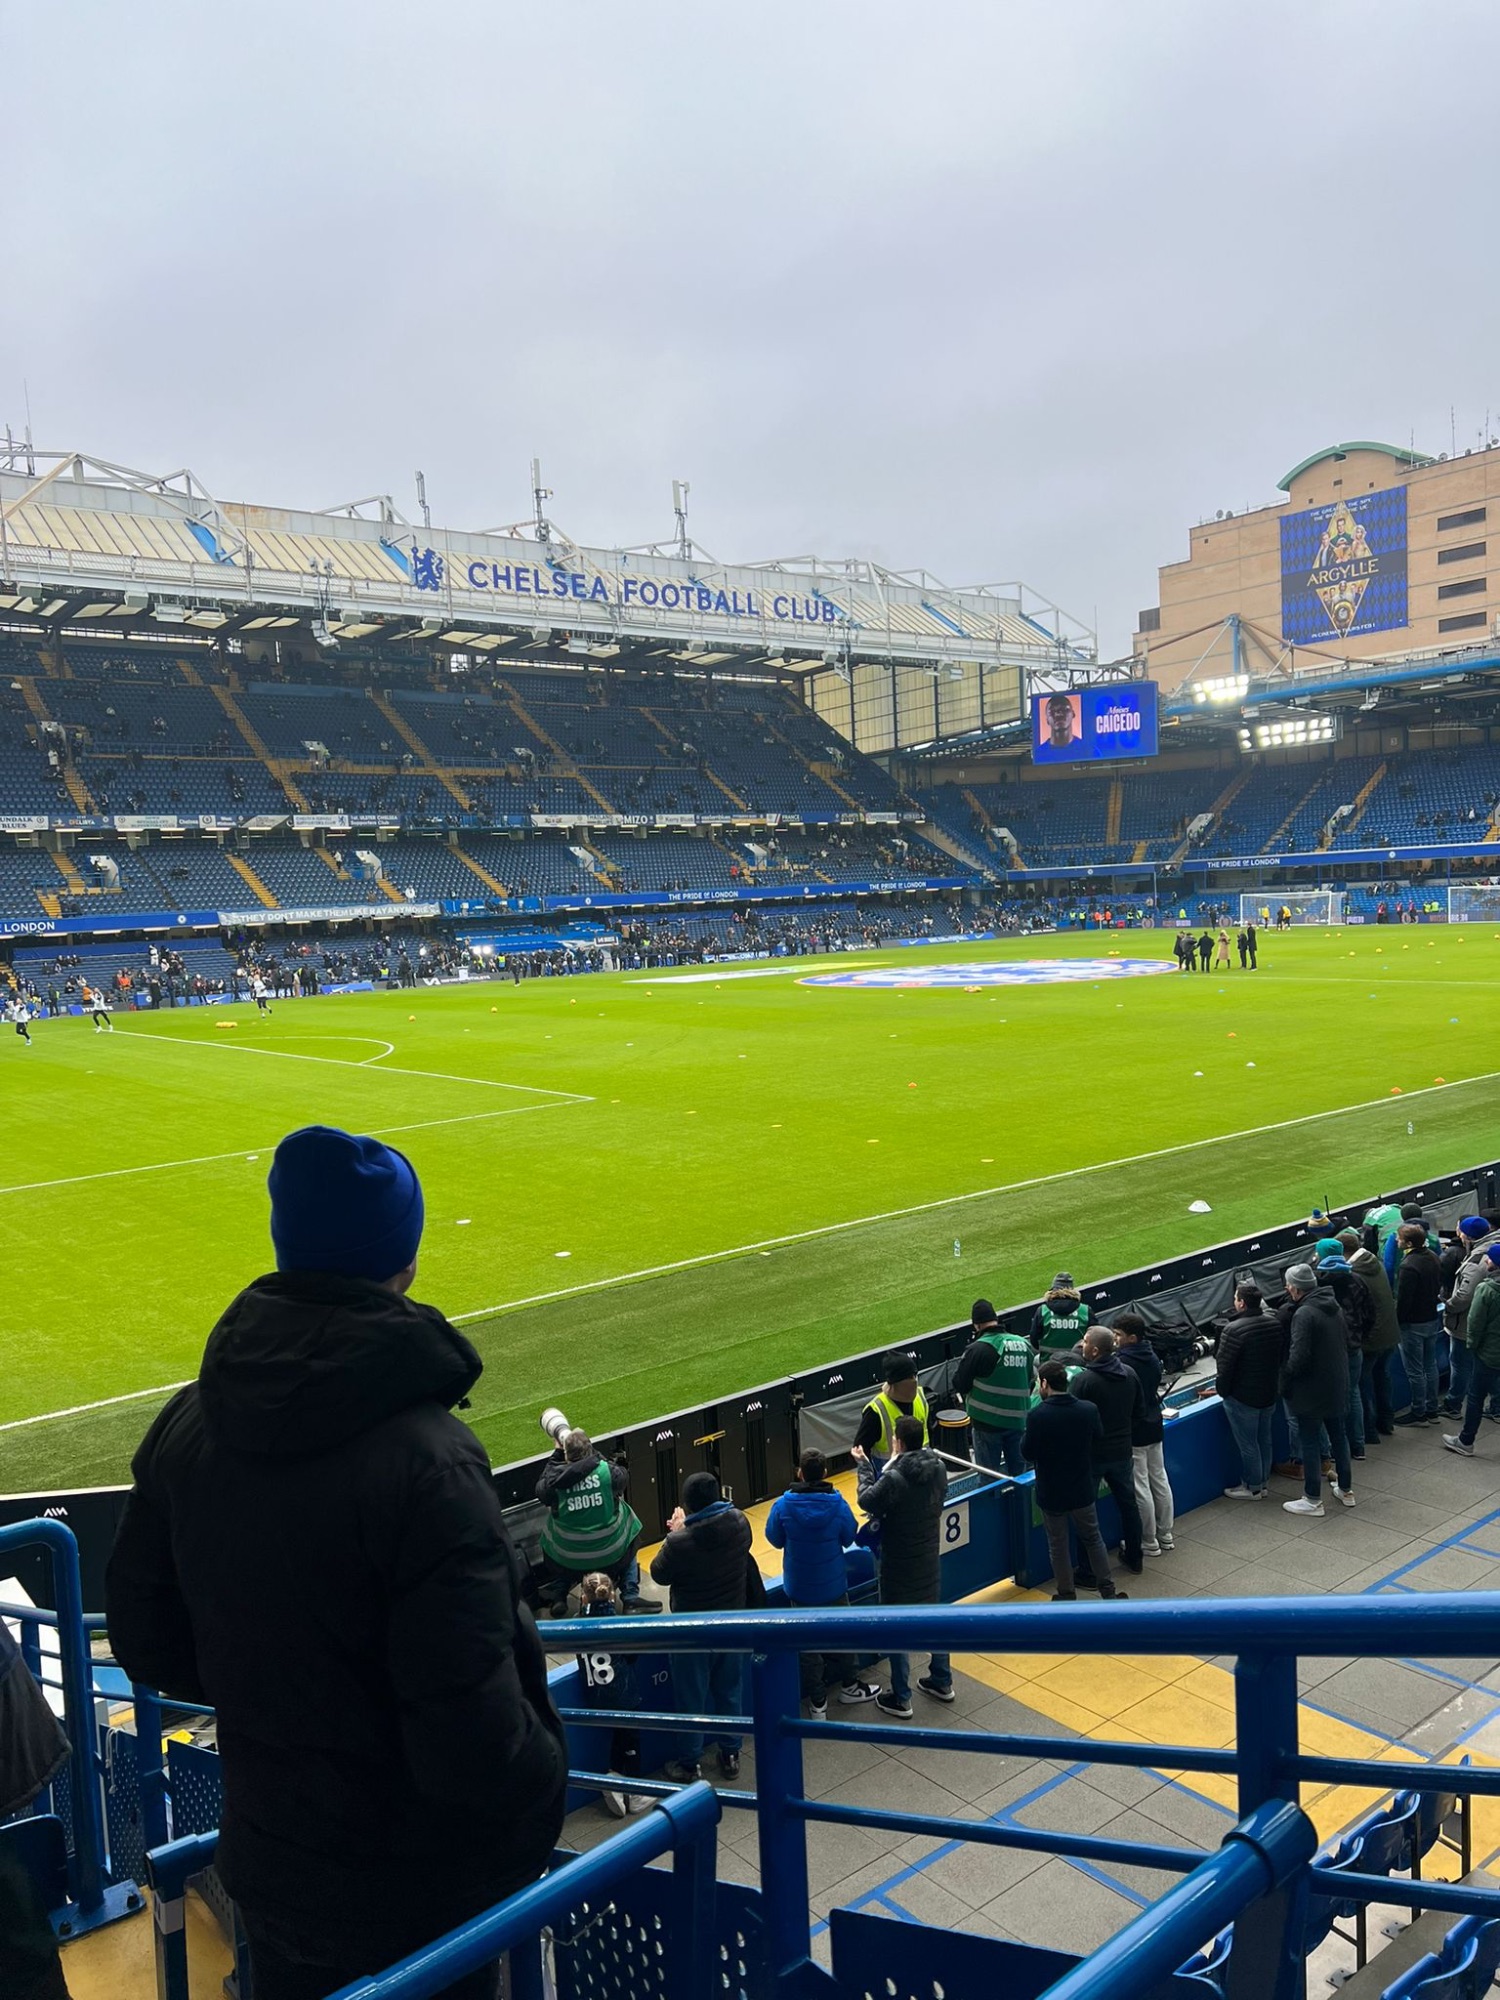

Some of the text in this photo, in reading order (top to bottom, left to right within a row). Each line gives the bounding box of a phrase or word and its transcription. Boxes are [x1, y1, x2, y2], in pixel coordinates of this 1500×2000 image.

[1307, 558, 1379, 587] ARGYLLE
[468, 561, 836, 623] CHELSEA FOOTBALL CLUB
[1096, 712, 1141, 733] CAICEDO
[624, 815, 648, 824] MIZO
[1251, 858, 1280, 866] LONDON
[683, 892, 702, 900] PRIDE
[711, 891, 739, 899] LONDON
[240, 914, 266, 922] THEY
[296, 910, 322, 918] MAKE
[325, 909, 348, 917] THEM
[349, 908, 369, 916] LIKE
[4, 921, 55, 933] LONDON
[1050, 1319, 1079, 1329] SB007
[567, 1492, 603, 1512] SB015
[945, 1511, 961, 1543] 8
[580, 1652, 615, 1687] 18
[652, 1670, 669, 1686] TO
